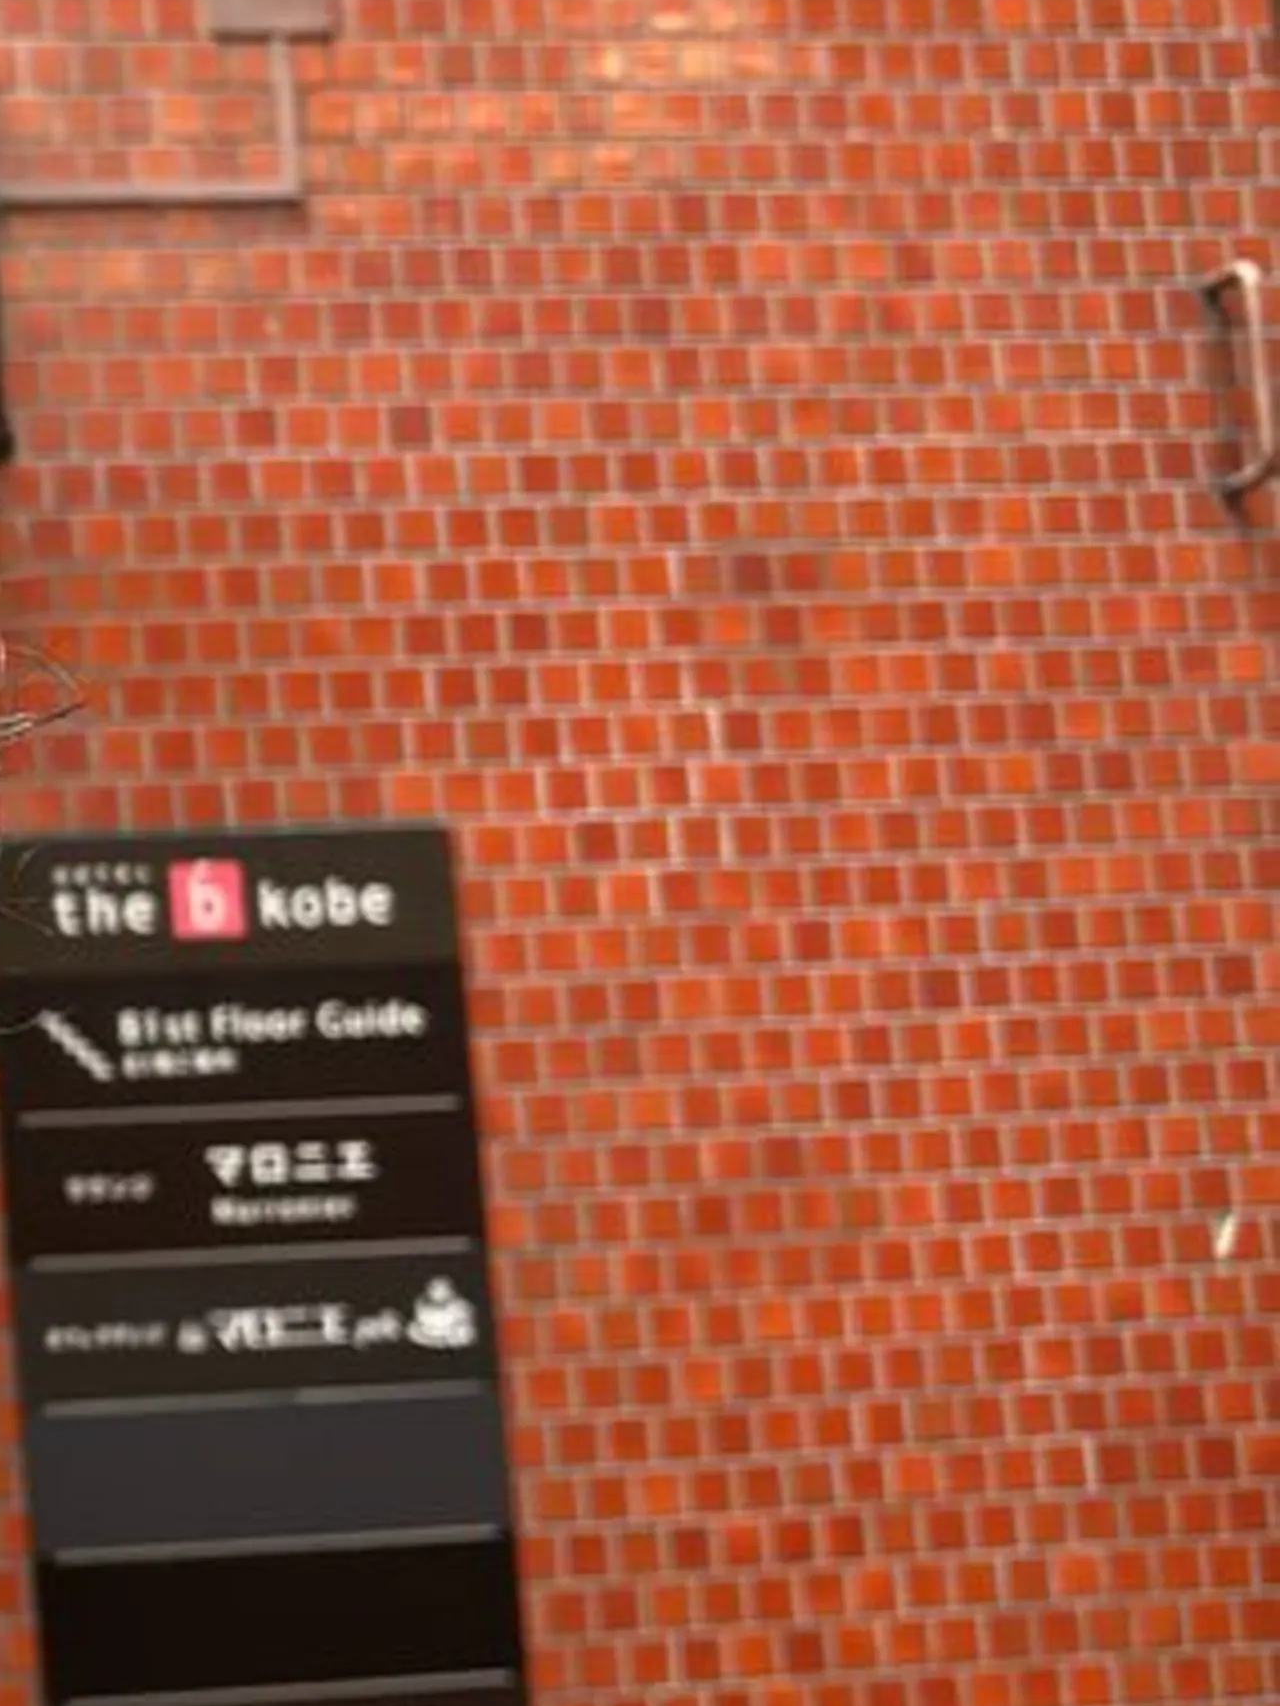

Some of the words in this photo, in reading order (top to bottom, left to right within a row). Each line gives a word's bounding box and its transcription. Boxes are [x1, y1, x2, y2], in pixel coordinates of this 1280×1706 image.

[52, 887, 156, 936] the
[256, 874, 395, 930] kobe
[209, 1002, 309, 1043] Floor
[314, 998, 428, 1040] Guide
